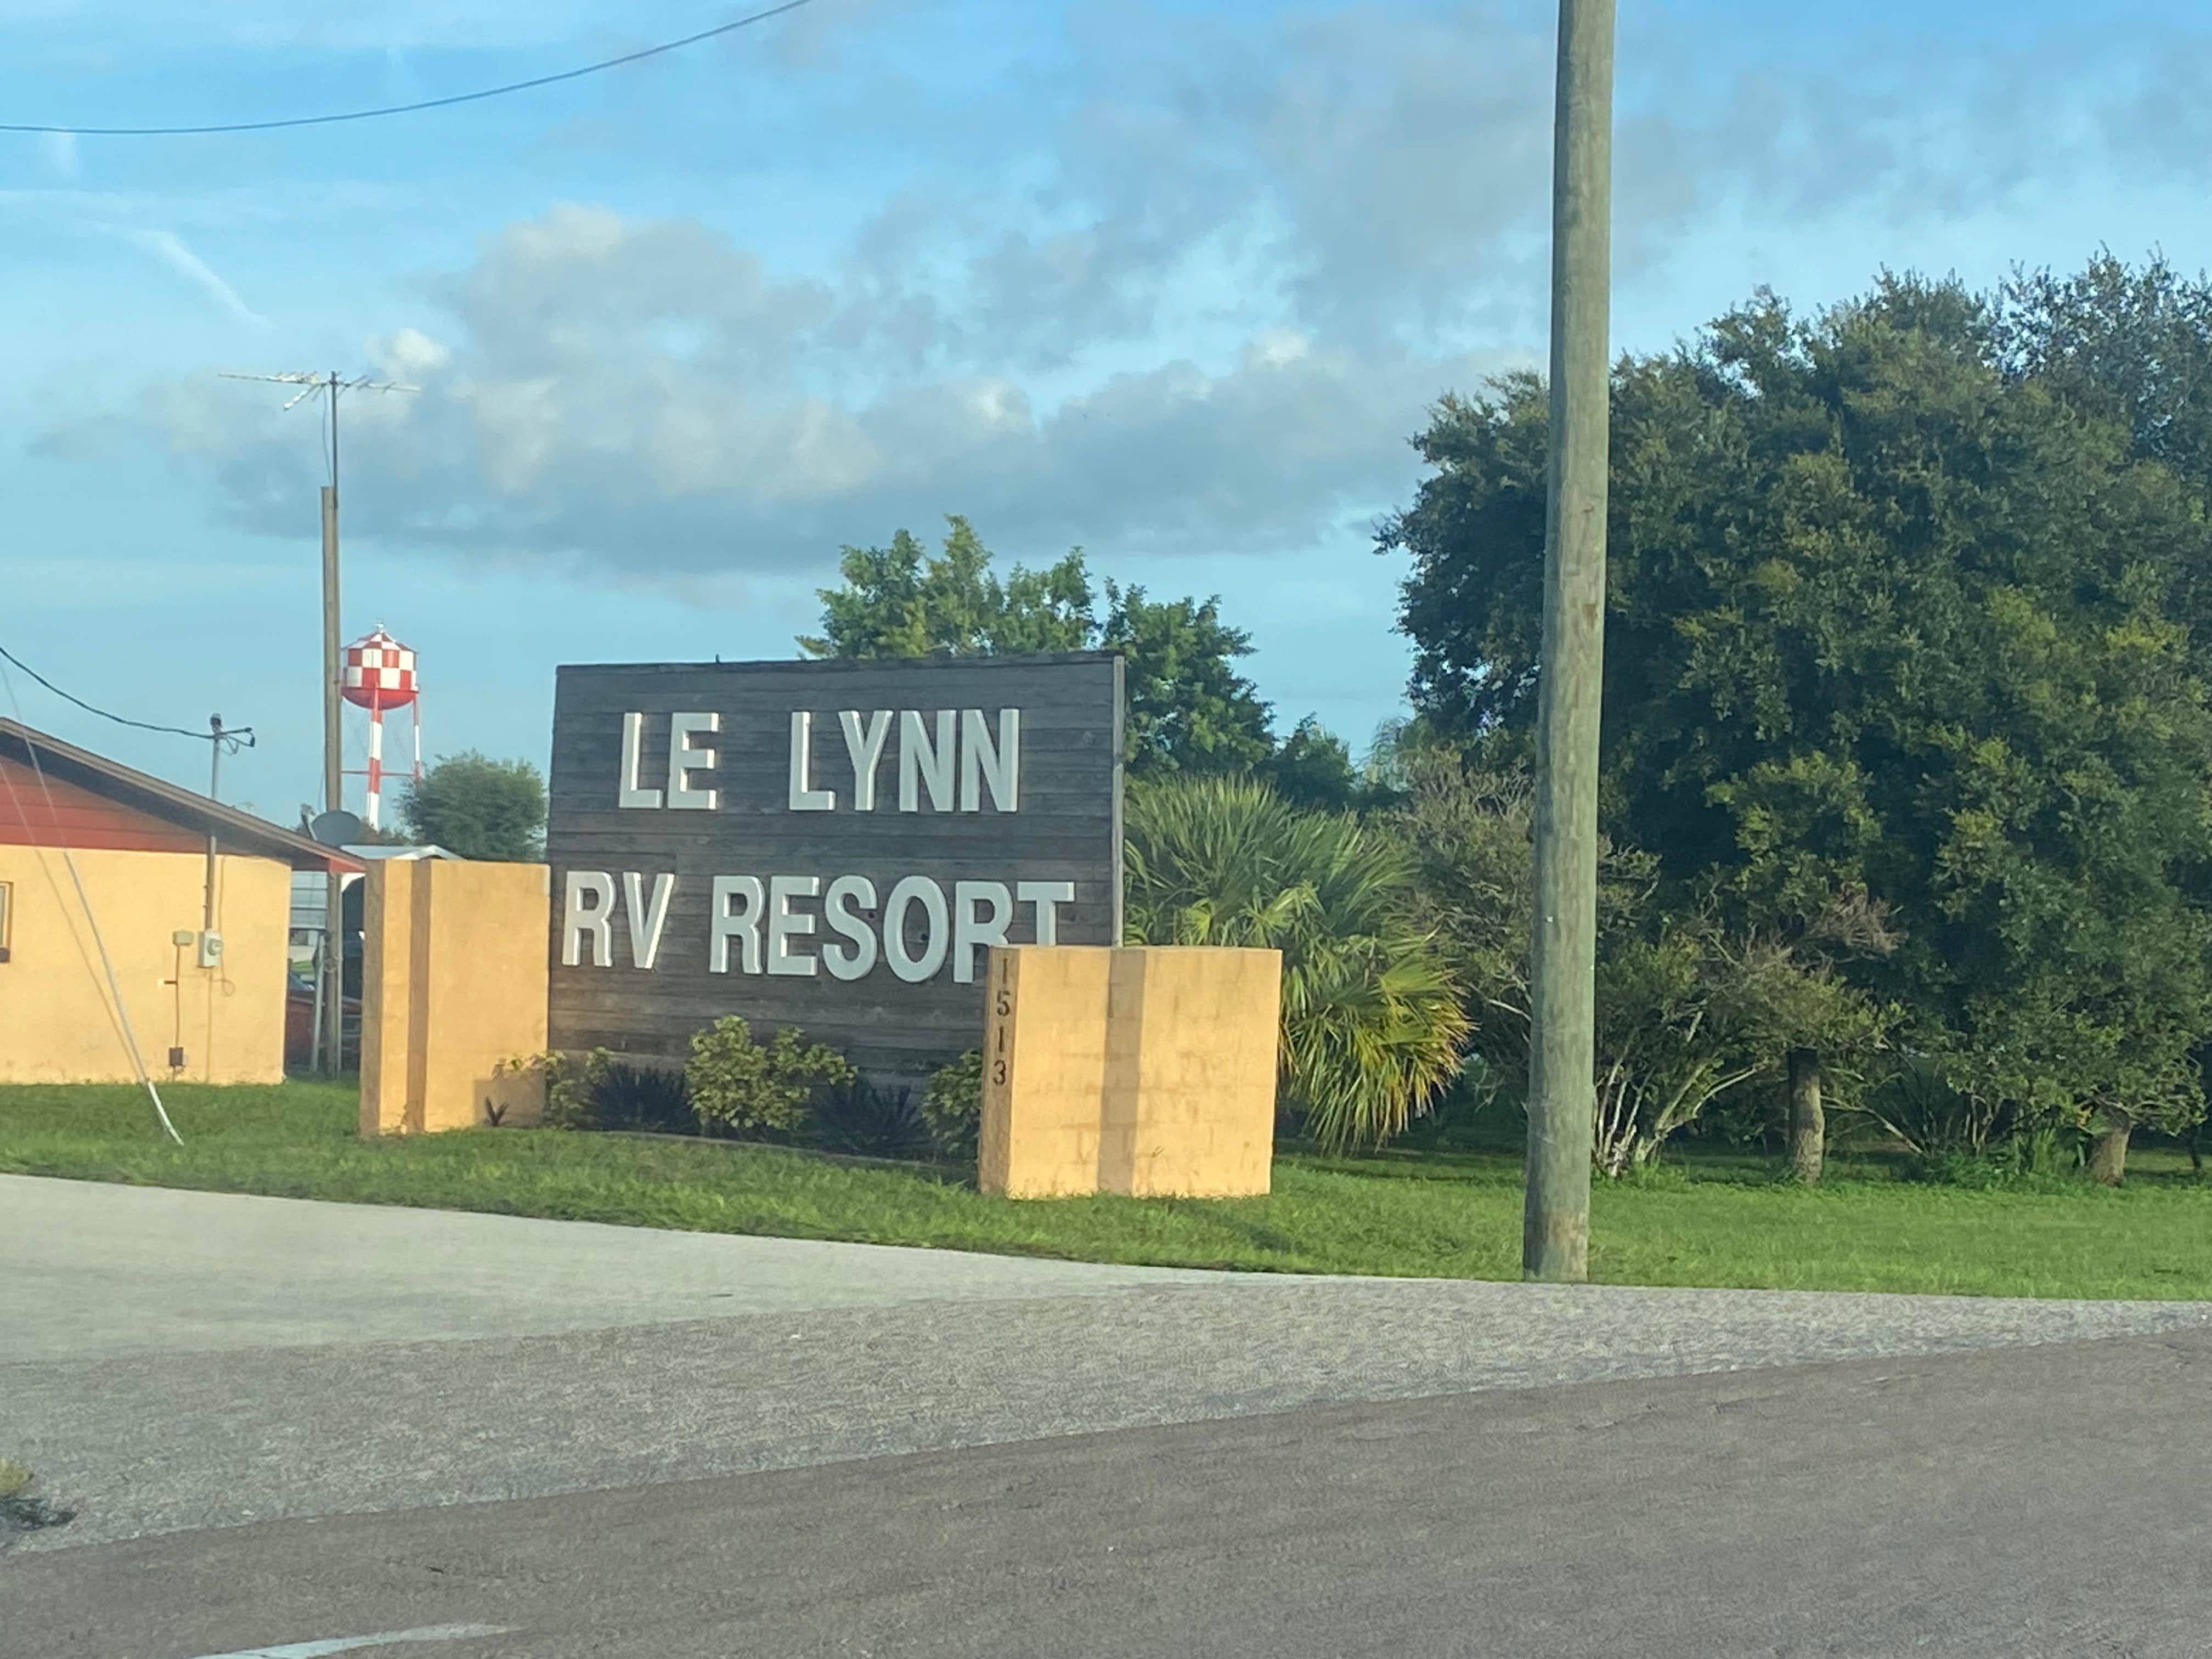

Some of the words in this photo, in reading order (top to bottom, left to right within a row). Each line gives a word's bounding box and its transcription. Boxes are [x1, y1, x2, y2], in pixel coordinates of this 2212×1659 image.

[618, 712, 720, 810] LE
[788, 708, 1020, 812] LYNN
[561, 870, 675, 969] RV
[709, 874, 1075, 983] RESORT
[993, 958, 1011, 1086] 1513
